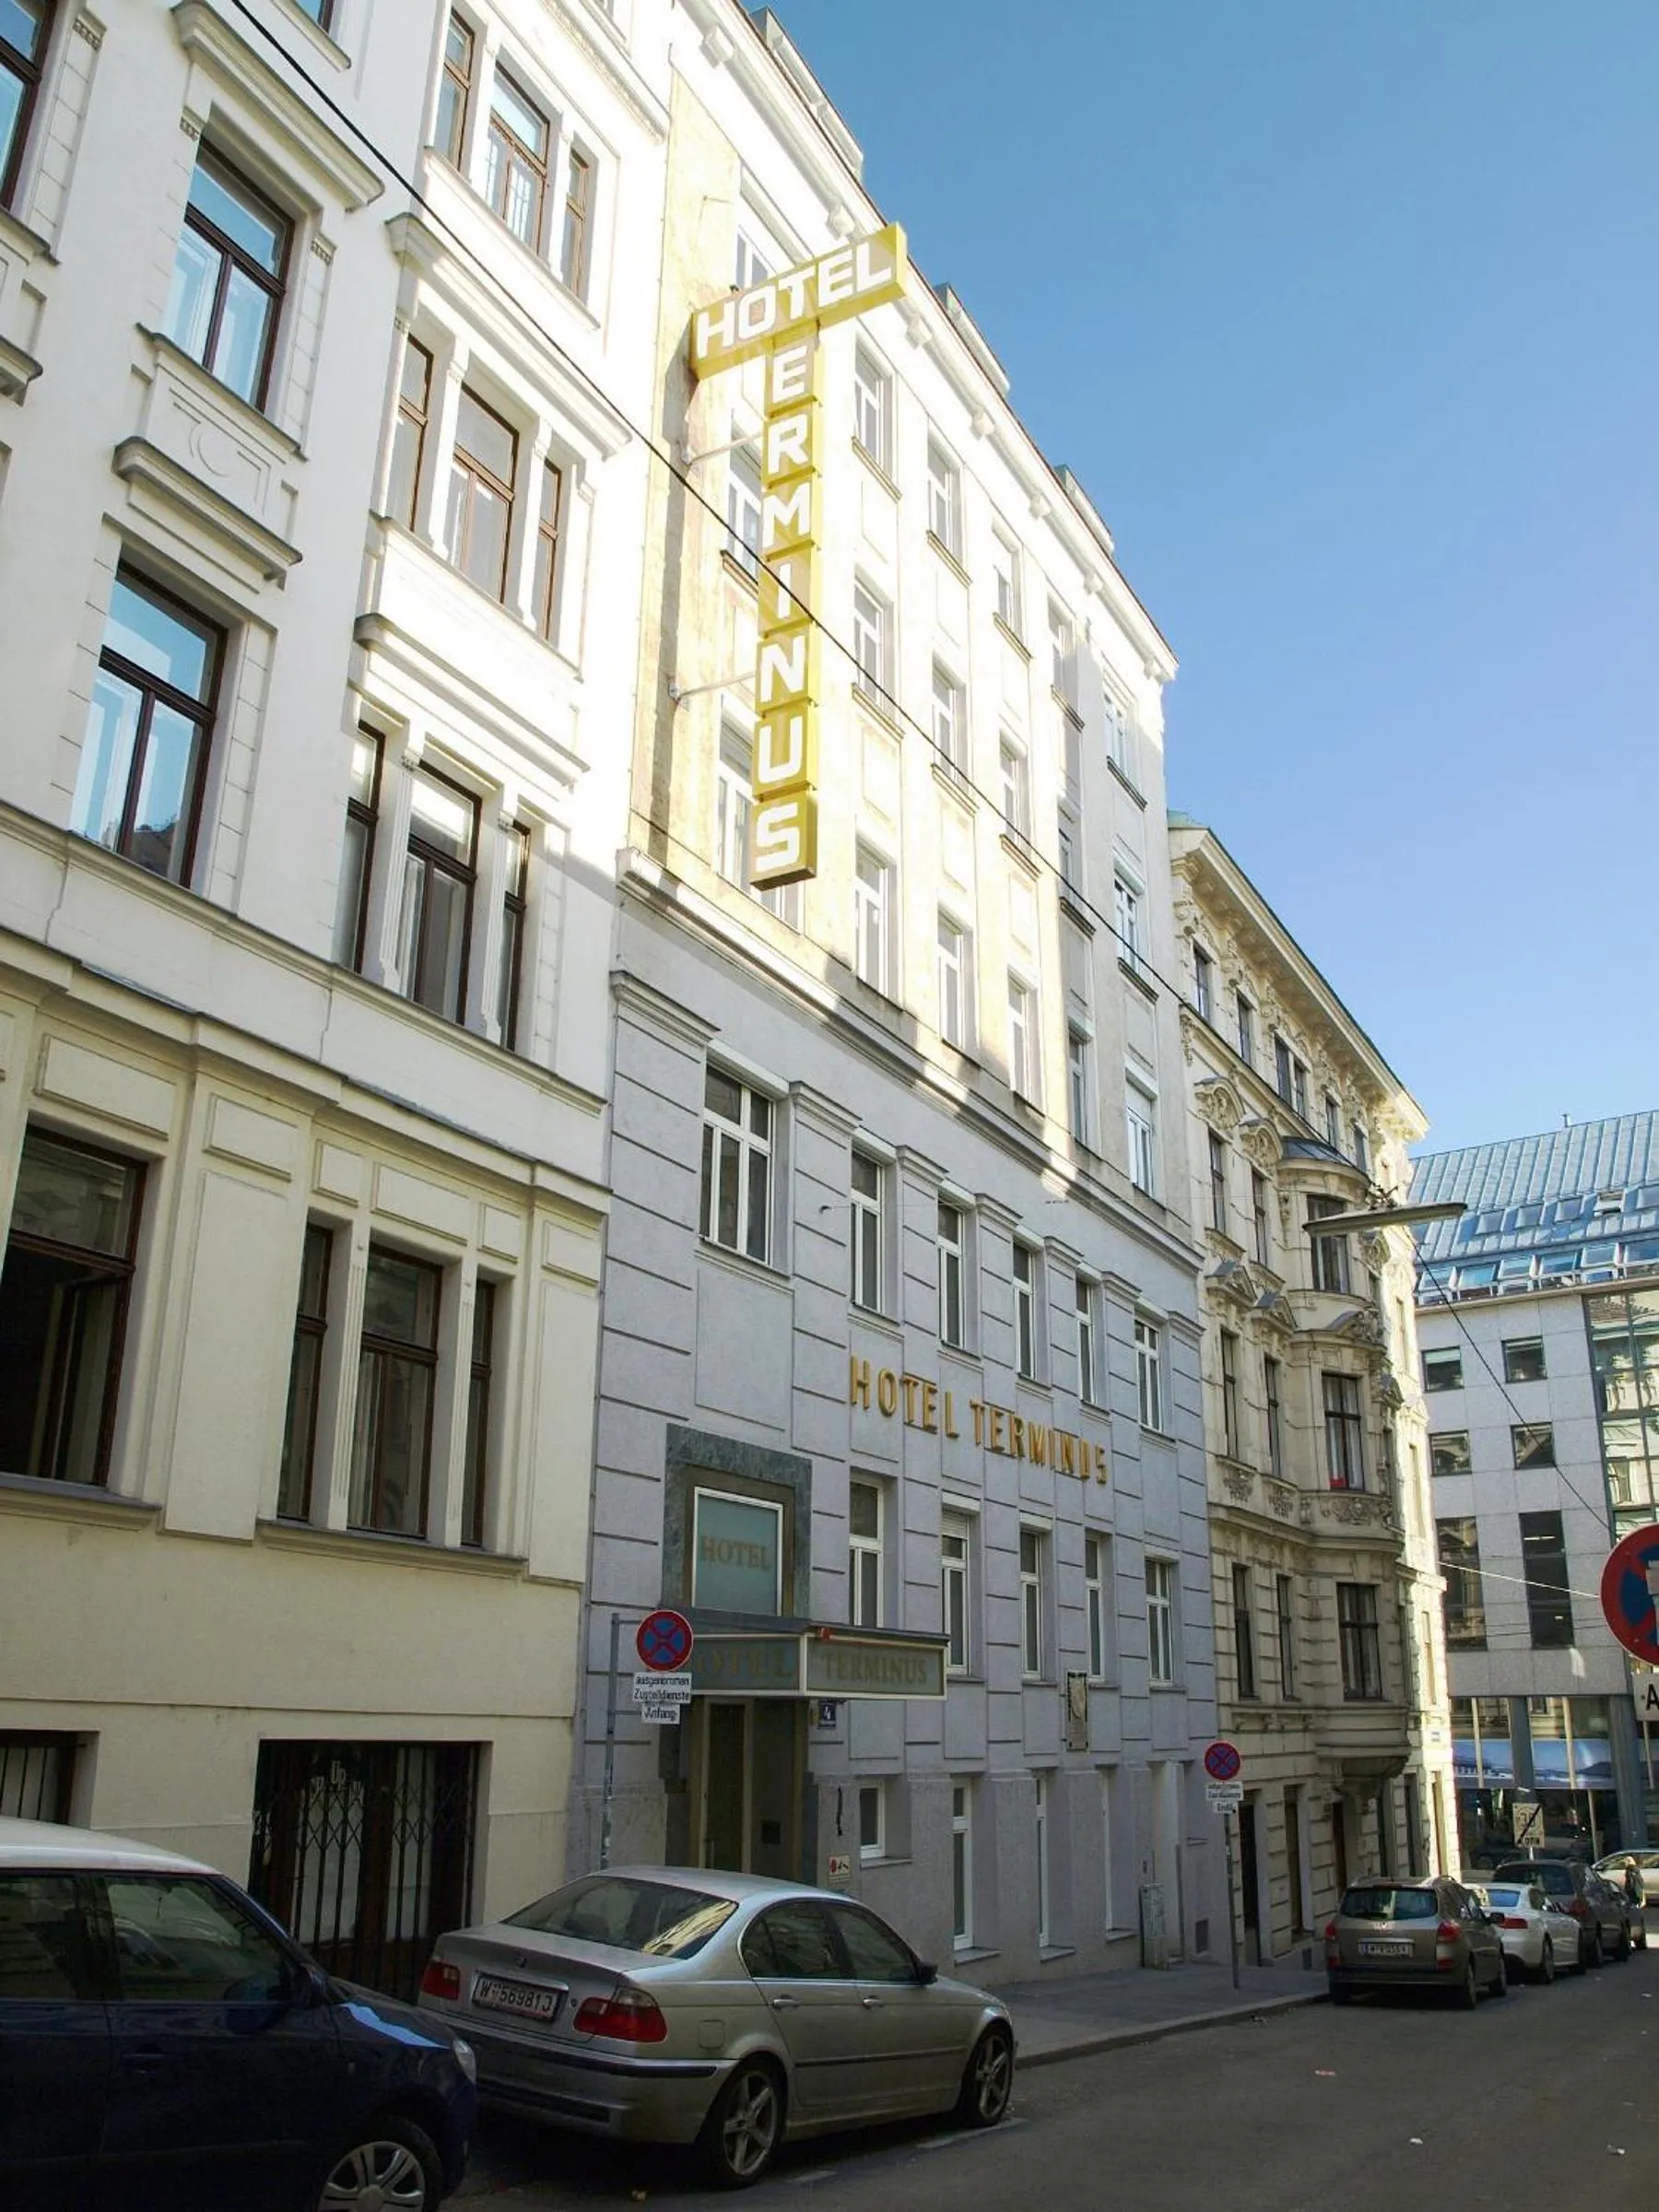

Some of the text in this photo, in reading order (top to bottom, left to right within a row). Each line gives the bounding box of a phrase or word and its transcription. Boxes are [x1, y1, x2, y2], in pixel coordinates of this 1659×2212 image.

[695, 240, 892, 360] HOTEL
[850, 1356, 1107, 1485] HOTEL TERMINUS
[700, 1535, 771, 1569] HOTEL
[822, 1650, 927, 1685] TERMINUS
